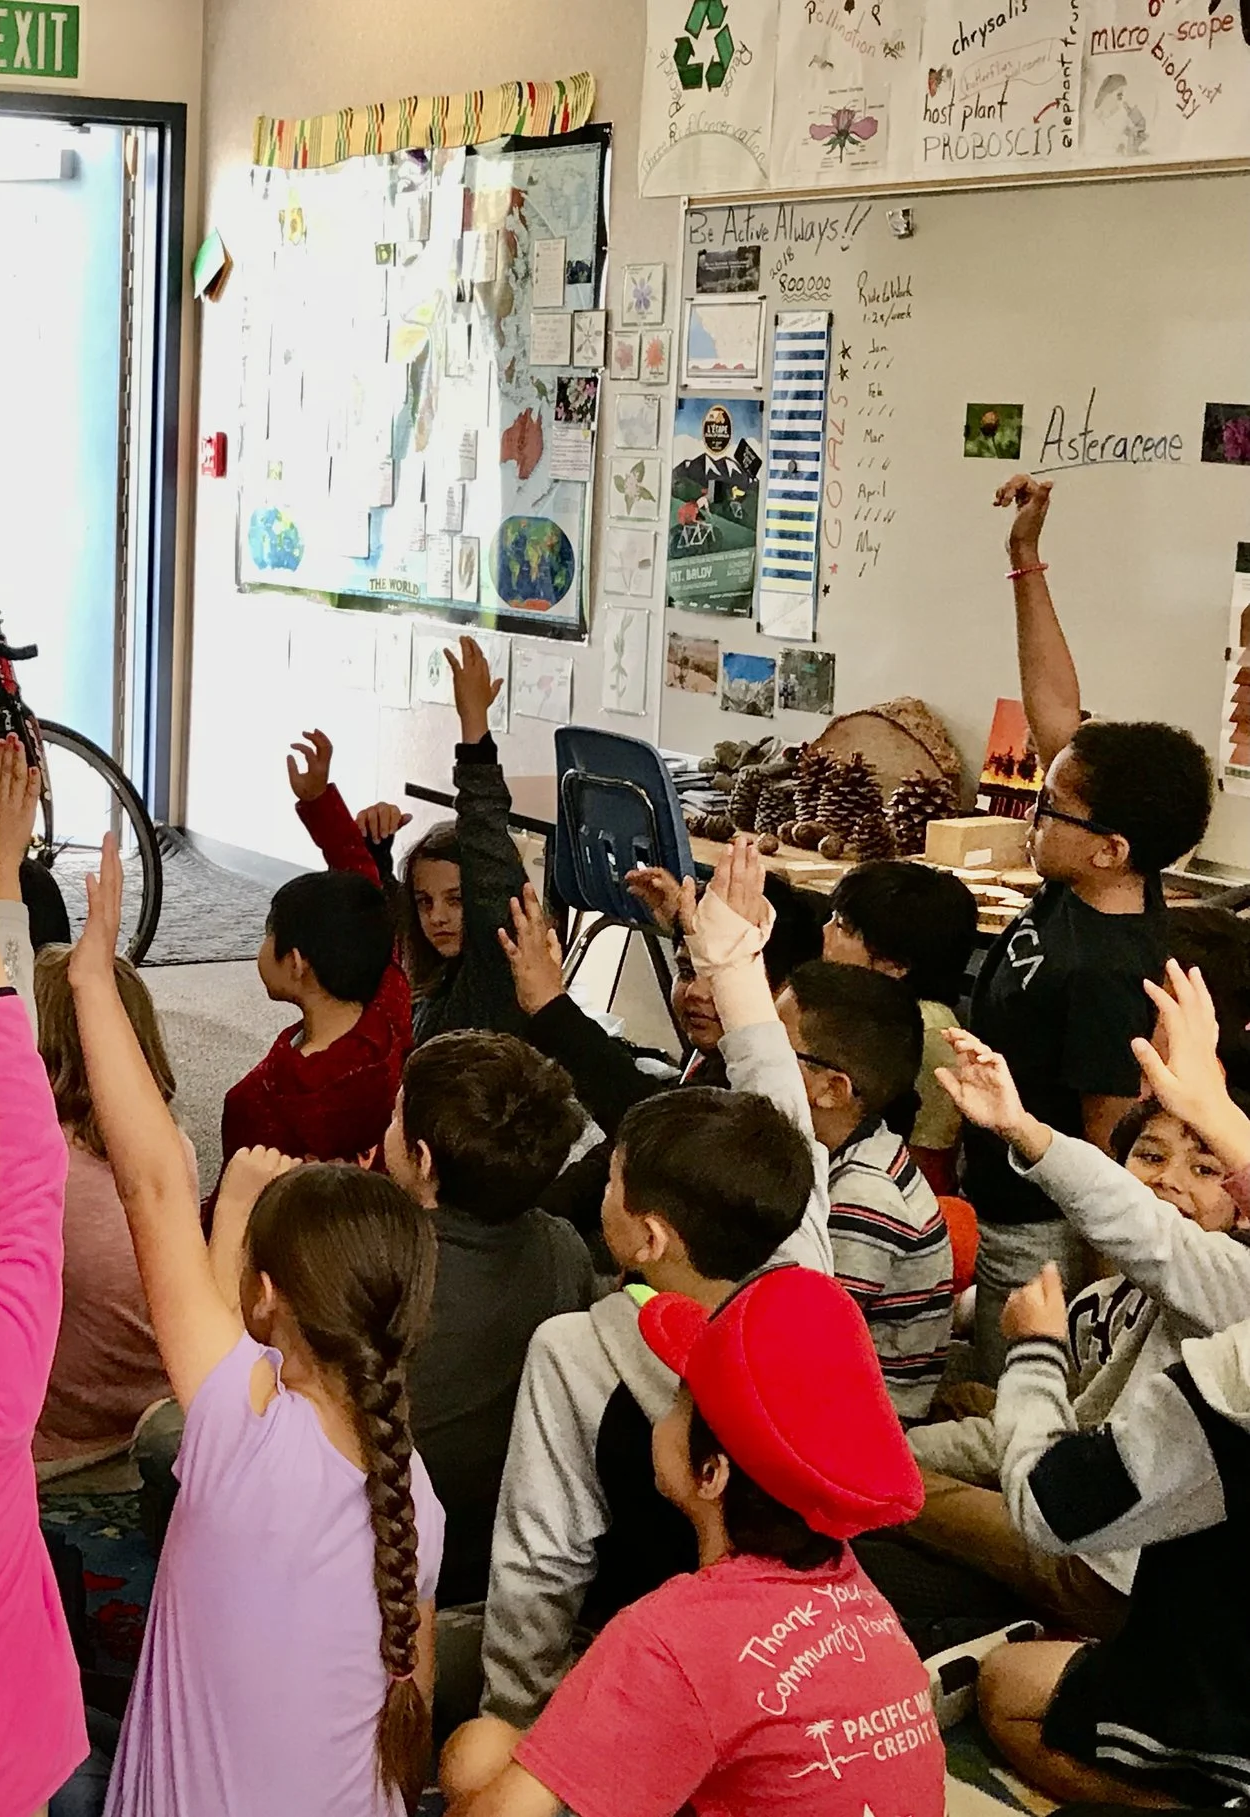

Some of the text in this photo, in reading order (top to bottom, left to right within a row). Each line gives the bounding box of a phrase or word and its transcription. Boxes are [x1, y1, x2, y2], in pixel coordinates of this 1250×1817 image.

[952, 0, 1028, 56] chrysalis
[1090, 26, 1150, 55] micro
[1151, 32, 1201, 119] biology
[923, 78, 1008, 132] host plant
[1057, 53, 1074, 148] elephant
[923, 125, 1056, 163] PROBOSCIS
[688, 211, 715, 245] Be
[721, 204, 769, 246] Active
[769, 245, 795, 281] 2018
[778, 273, 832, 294] 800,000
[1039, 386, 1184, 463] Asteraceae
[824, 385, 849, 549] GOALS
[856, 479, 887, 503] April
[855, 529, 881, 567] May
[369, 578, 420, 596] THE WORLD
[738, 1600, 822, 1669] Thank
[812, 1583, 862, 1612] You
[757, 1618, 866, 1716] Community
[842, 1697, 918, 1745] PACIFIC
[872, 1722, 934, 1762] CREDIT
